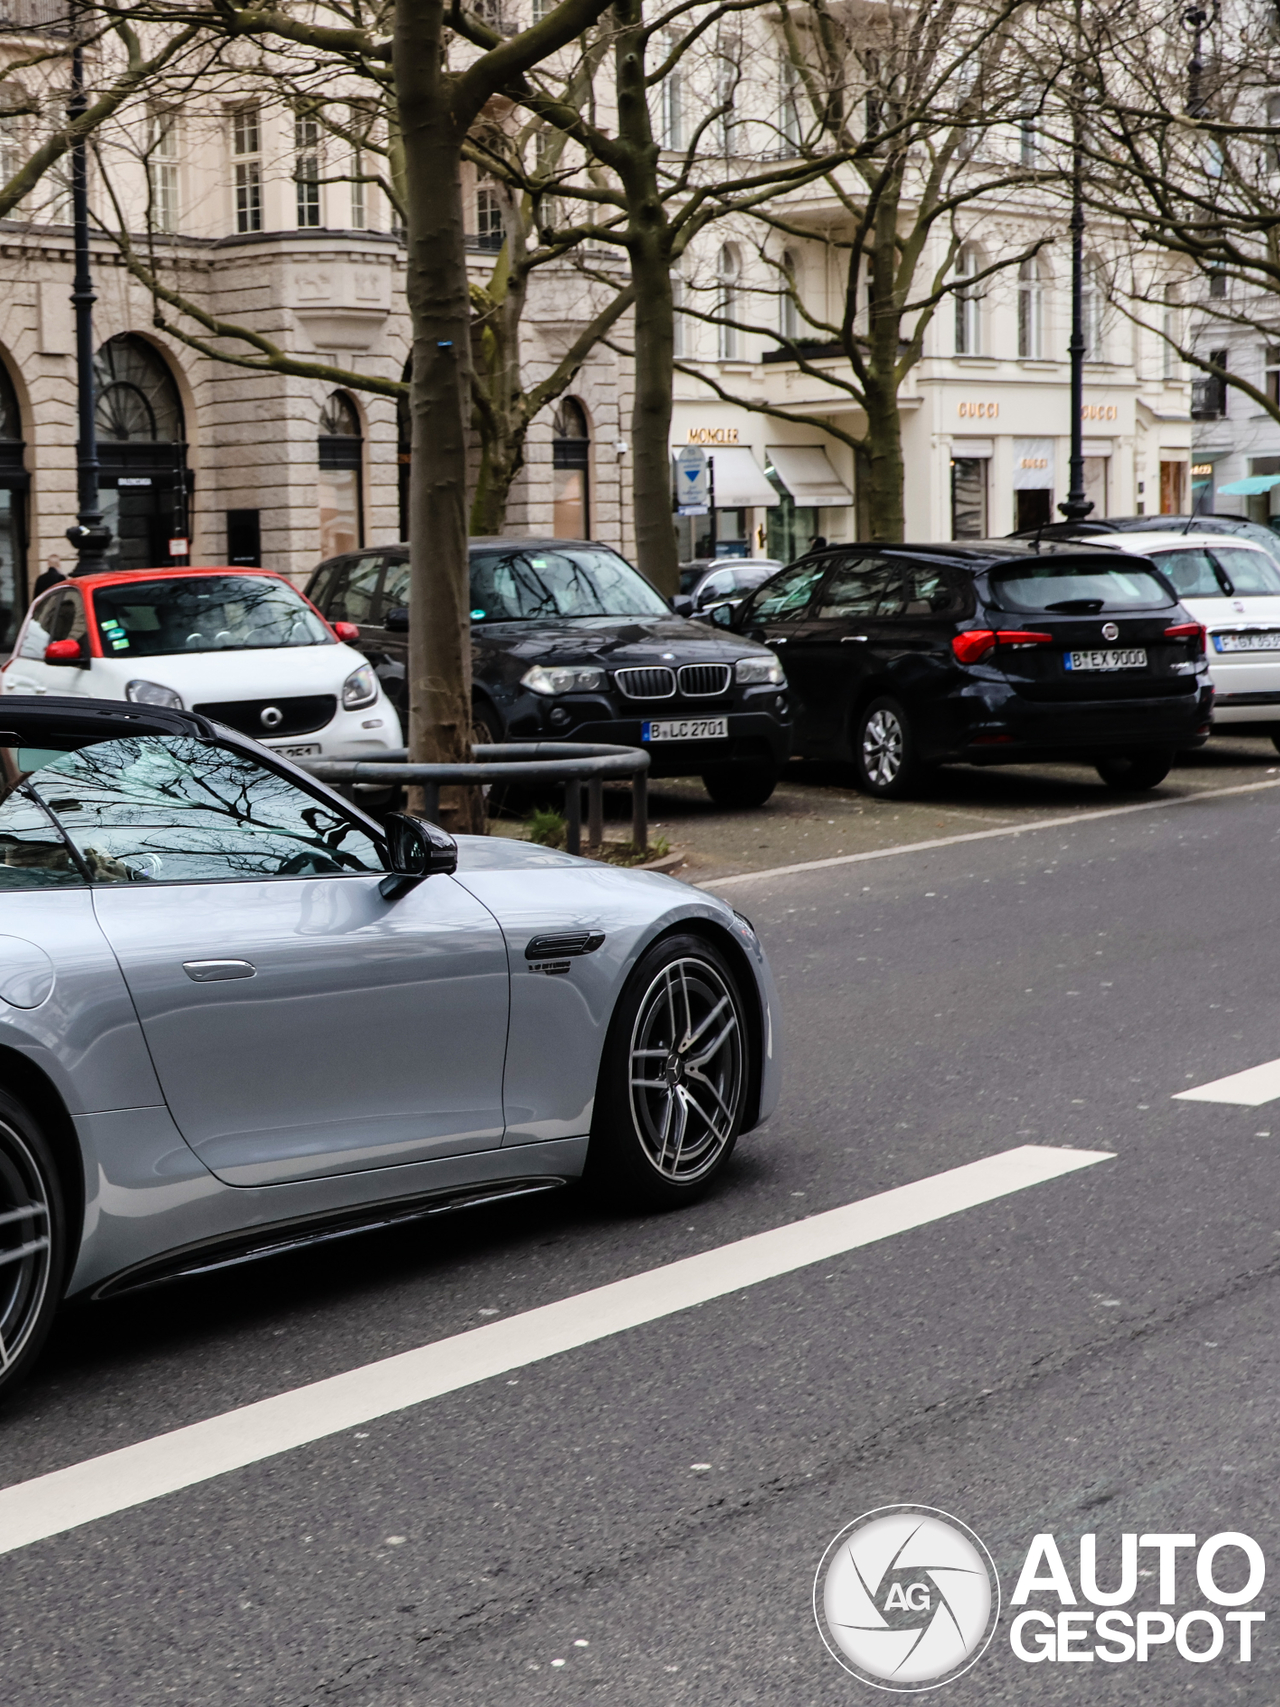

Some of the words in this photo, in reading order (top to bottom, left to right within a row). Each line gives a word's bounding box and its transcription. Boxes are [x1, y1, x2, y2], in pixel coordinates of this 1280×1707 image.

[958, 402, 999, 419] GUCCI
[1081, 405, 1117, 420] GUCCI
[687, 428, 739, 444] MONCLER
[1021, 458, 1048, 469] GUCCI
[1072, 654, 1083, 668] B
[1091, 652, 1109, 667] EX
[1112, 650, 1146, 666] 9000
[651, 724, 660, 739] B
[670, 722, 688, 738] LC
[691, 721, 724, 737] 2701
